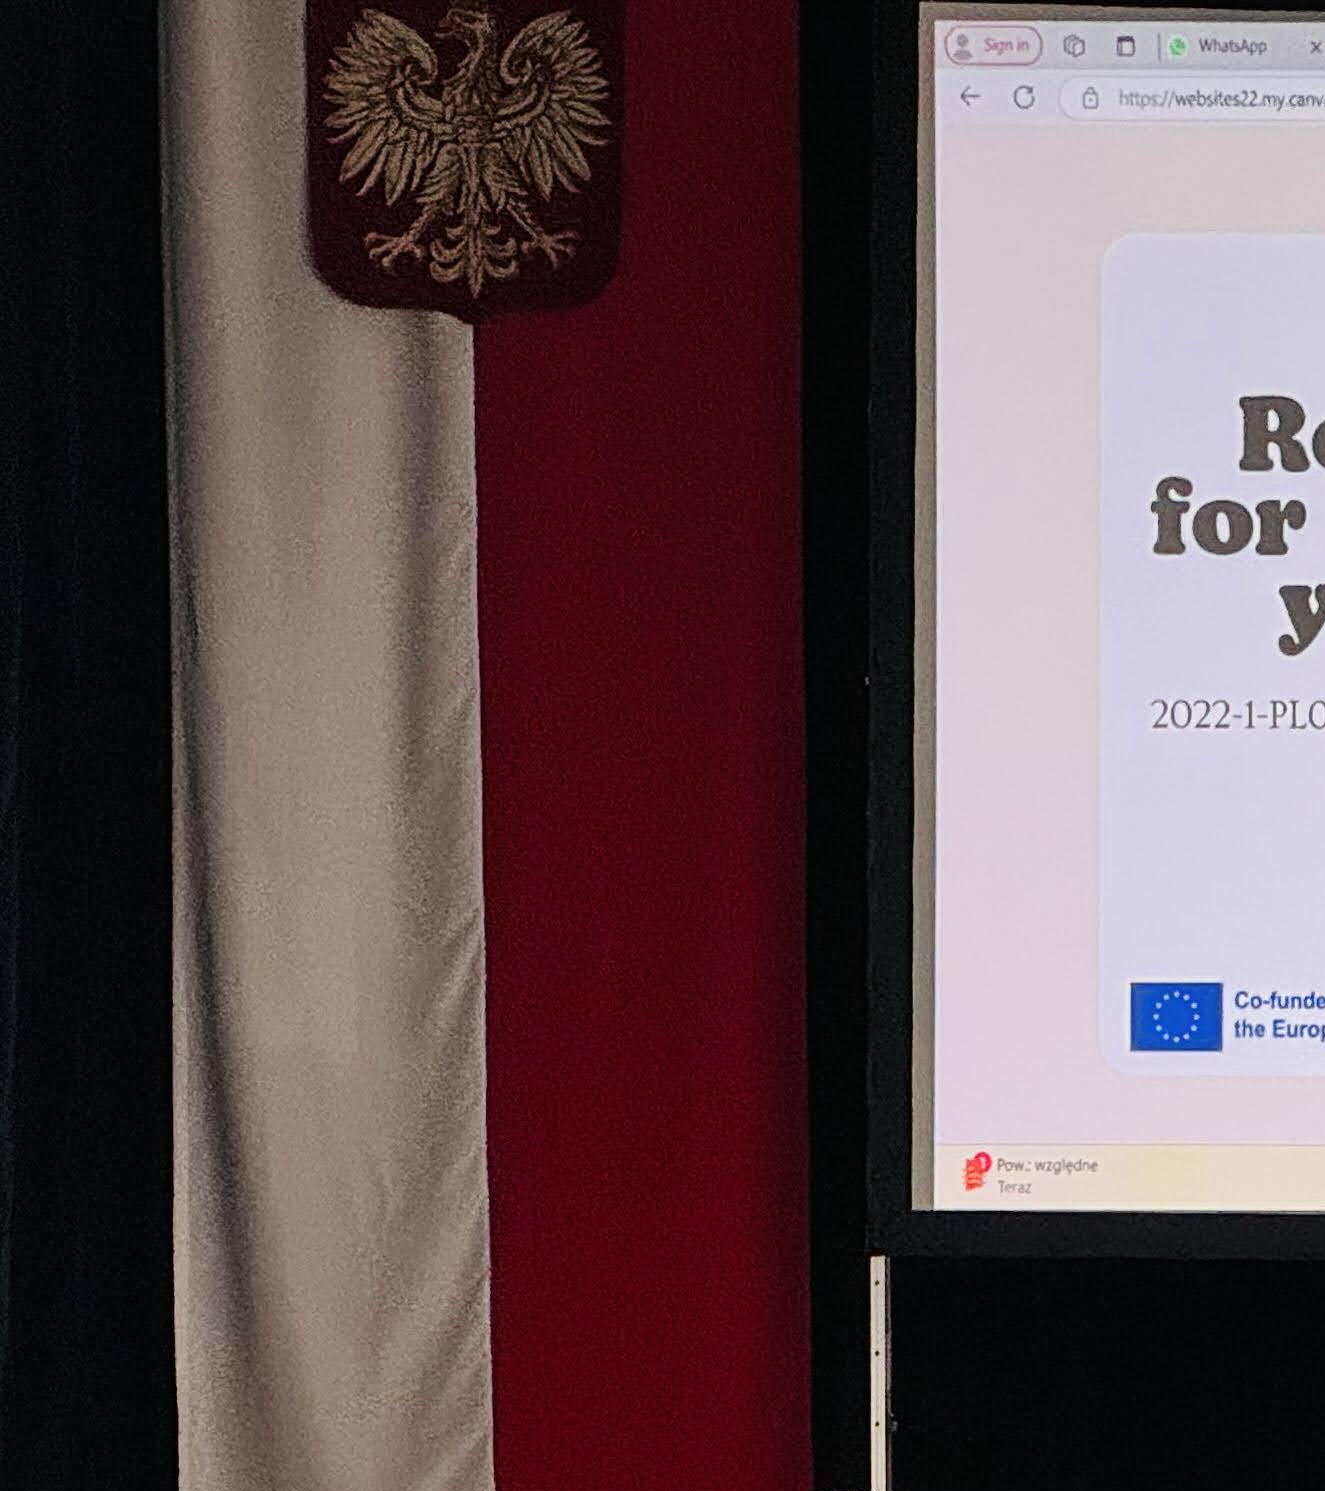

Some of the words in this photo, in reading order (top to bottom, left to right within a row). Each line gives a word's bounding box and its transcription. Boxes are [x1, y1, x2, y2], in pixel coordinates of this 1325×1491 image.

[984, 38, 1014, 55] Sign
[1017, 38, 1030, 51] in
[1198, 38, 1268, 55] WhatsApp
[1151, 476, 1306, 556] for
[1234, 1020, 1266, 1039] the
[1034, 1159, 1098, 1175] względne
[998, 1180, 1032, 1194] Teraz
